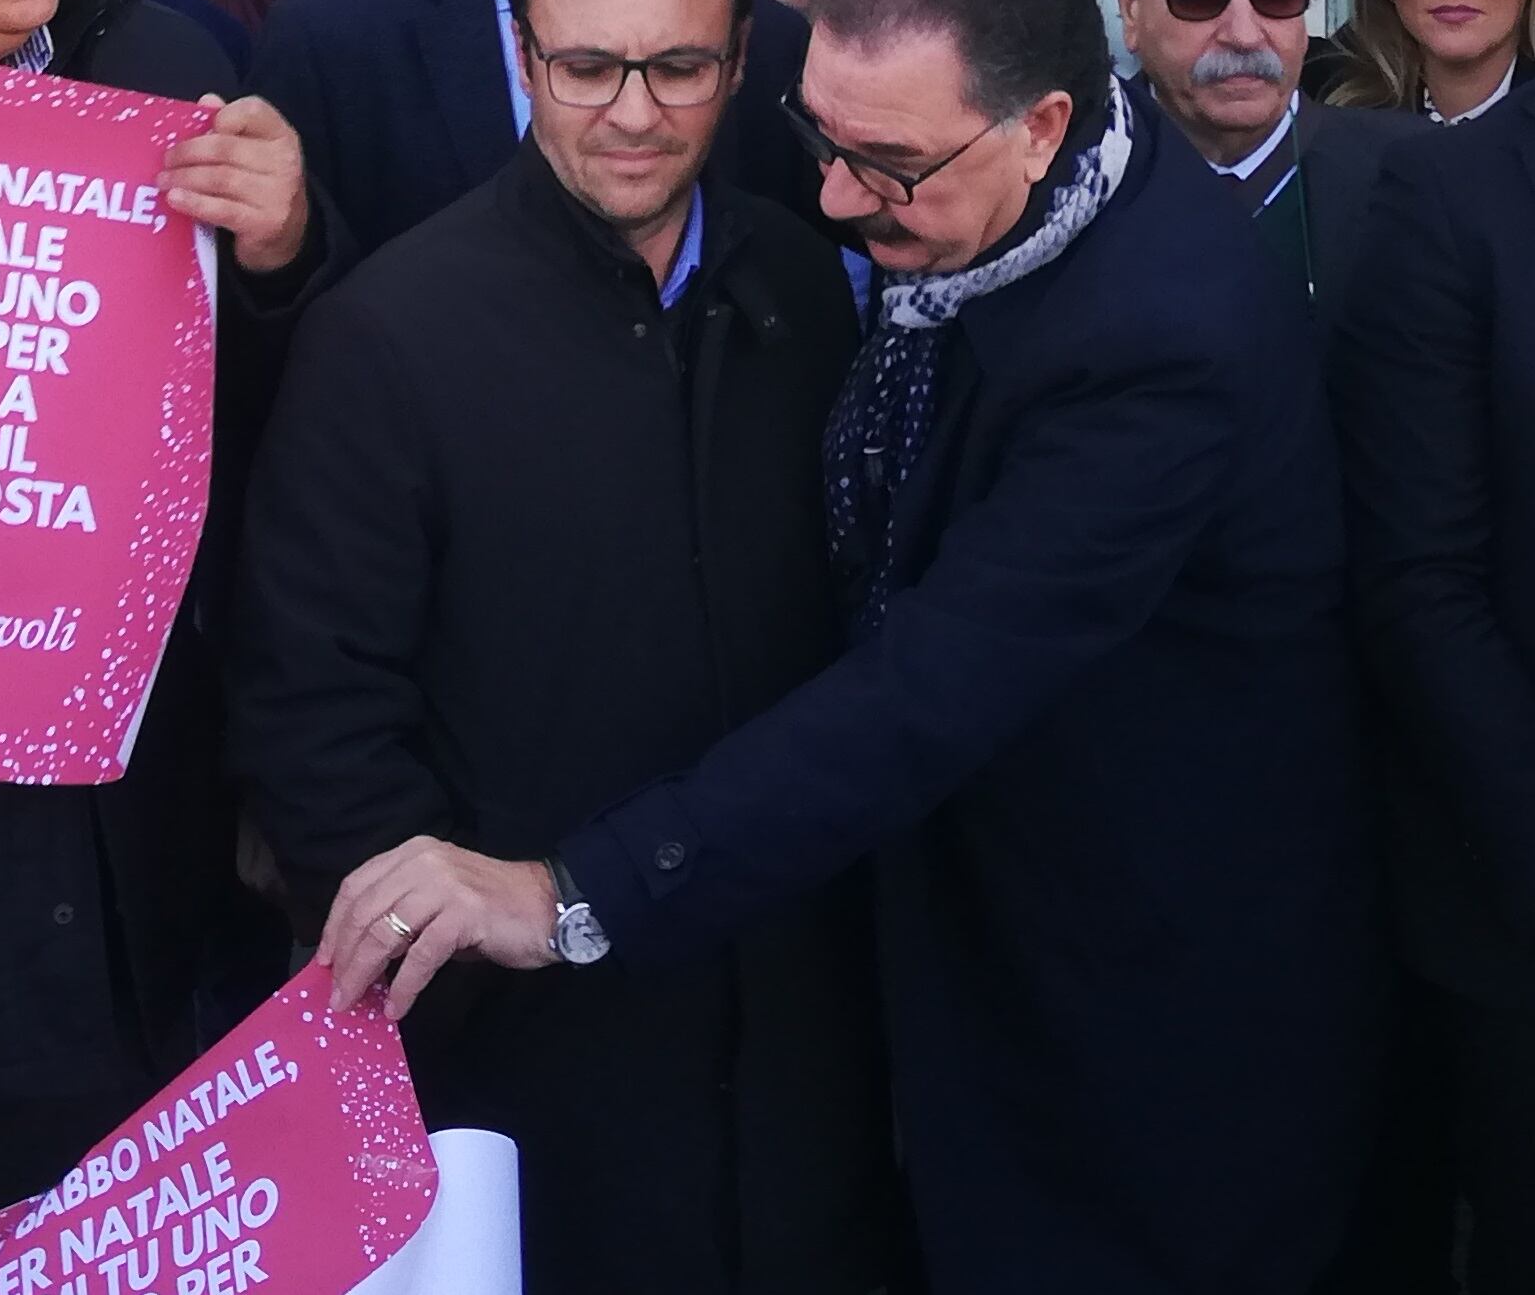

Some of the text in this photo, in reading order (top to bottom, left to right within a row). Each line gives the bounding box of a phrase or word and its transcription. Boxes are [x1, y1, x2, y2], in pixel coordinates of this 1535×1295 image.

[143, 1040, 298, 1162] NATALE,
[60, 1141, 235, 1276] NATALE
[98, 1178, 278, 1295] TU UNO
